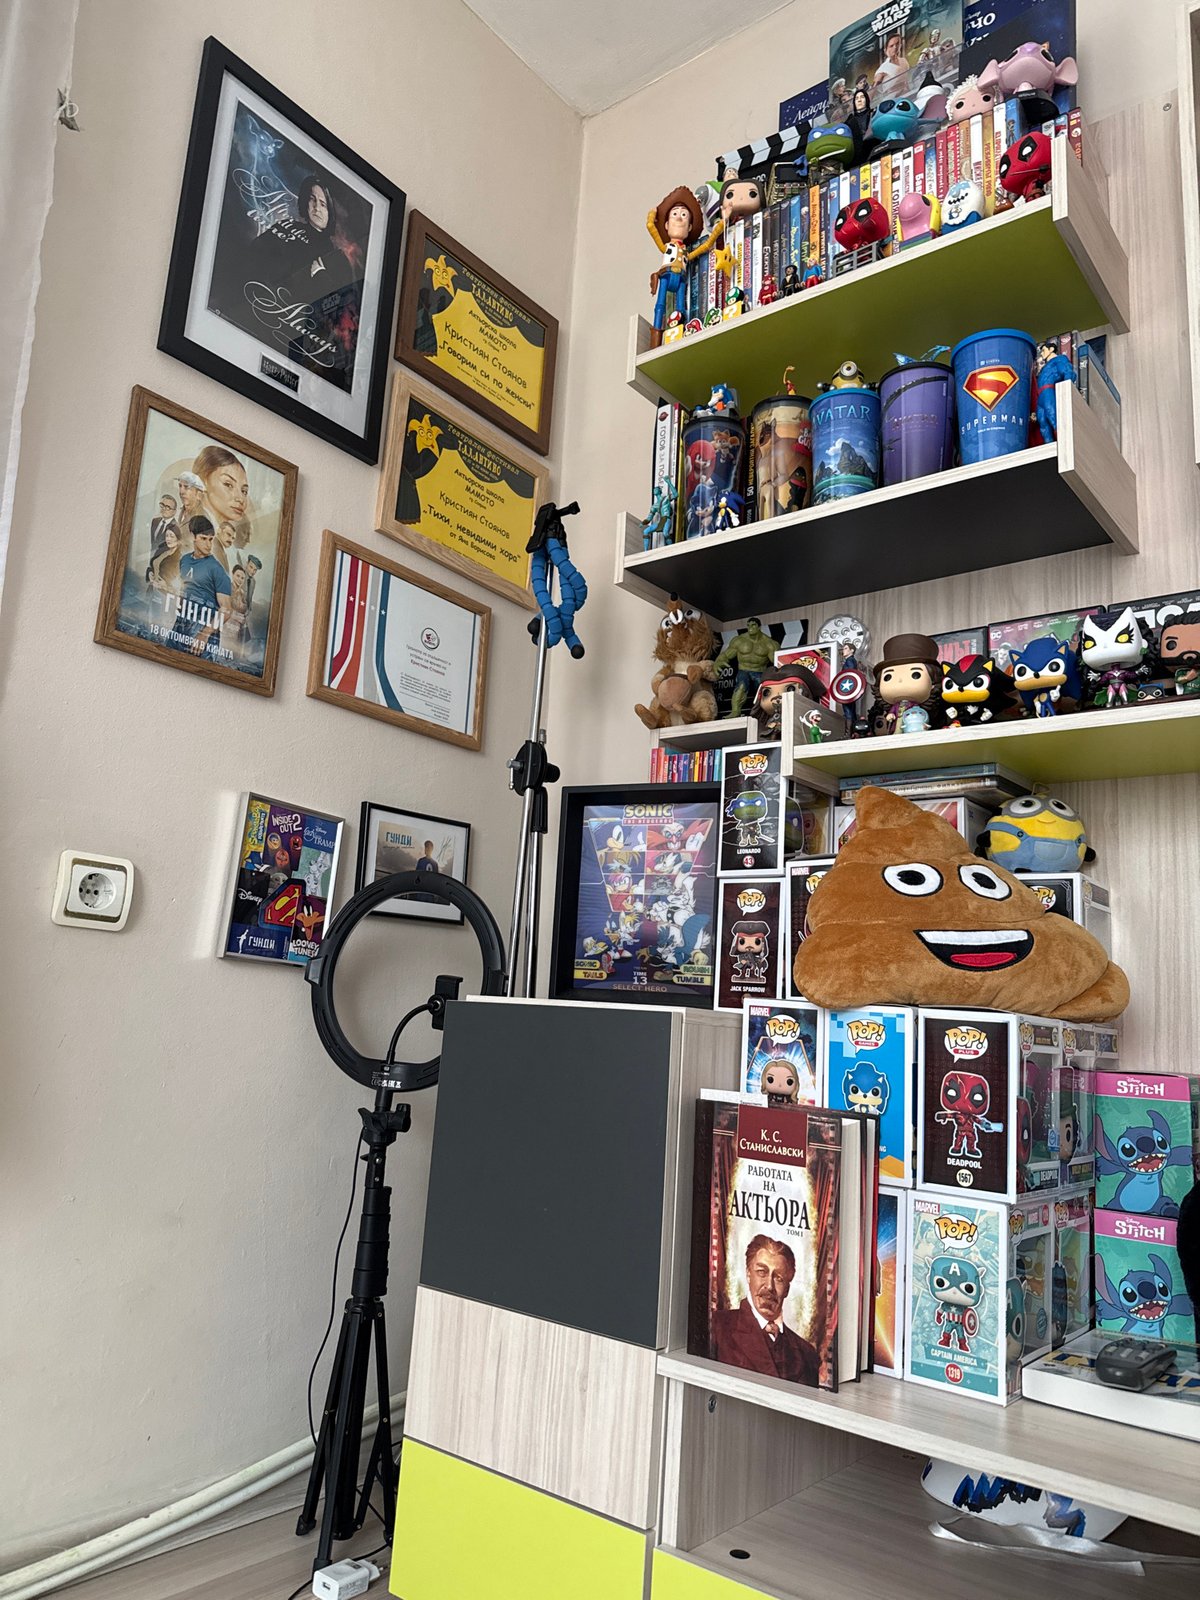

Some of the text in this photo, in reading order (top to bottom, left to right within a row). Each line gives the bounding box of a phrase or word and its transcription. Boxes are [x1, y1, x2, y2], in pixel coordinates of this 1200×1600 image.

[871, 6, 912, 32] WARS
[244, 281, 336, 367] Always
[479, 327, 508, 351] МАМОТО
[444, 321, 490, 362] Кристиян
[491, 356, 527, 389] Стоянов
[480, 369, 490, 381] си
[493, 378, 503, 389] по
[812, 404, 871, 426] VATAR
[961, 413, 1024, 435] SUPERMAN
[447, 424, 486, 454] Театрален
[465, 485, 495, 508] МАМОТО
[747, 486, 754, 497] 50
[440, 491, 510, 539] Кристиян Стоянов
[456, 523, 497, 551] невидими
[164, 593, 224, 632] ГУНДИ
[150, 623, 159, 636] 18
[160, 629, 199, 649] ОКТОМВРИ
[206, 643, 234, 661] КИНАТА
[740, 755, 767, 772] POP!
[625, 804, 673, 818] SONIC
[280, 825, 293, 834] OUT
[386, 832, 412, 846] ГУНДИ
[743, 856, 755, 866] 43
[791, 867, 809, 877] MARVEL
[238, 888, 263, 906] Disney
[737, 891, 766, 908] POP!
[248, 936, 275, 950] ГУНДИ
[292, 939, 320, 951] LOONEY
[582, 971, 604, 979] TAILS
[633, 976, 648, 985] 13
[676, 976, 705, 984] TUMBLE
[613, 983, 668, 993] SELECT HERO
[750, 1007, 770, 1017] MARVEL
[766, 1018, 800, 1038] POP!
[847, 1020, 886, 1041] POP!
[945, 1027, 987, 1050] POP!
[761, 1129, 783, 1143] К. С.
[946, 1157, 982, 1170] DEADPOOL
[748, 1165, 793, 1182] РАБОТАТА
[958, 1171, 972, 1183] 1567
[763, 1180, 777, 1193] НА
[728, 1189, 811, 1230] АКТЬОРА
[915, 1200, 940, 1215] MARVEL
[786, 1229, 800, 1238] ТОМ
[934, 1217, 977, 1243] POP!
[949, 1262, 960, 1276] A
[930, 1347, 978, 1367] CAPTAIN AMERICA
[947, 1366, 961, 1380] 1319
